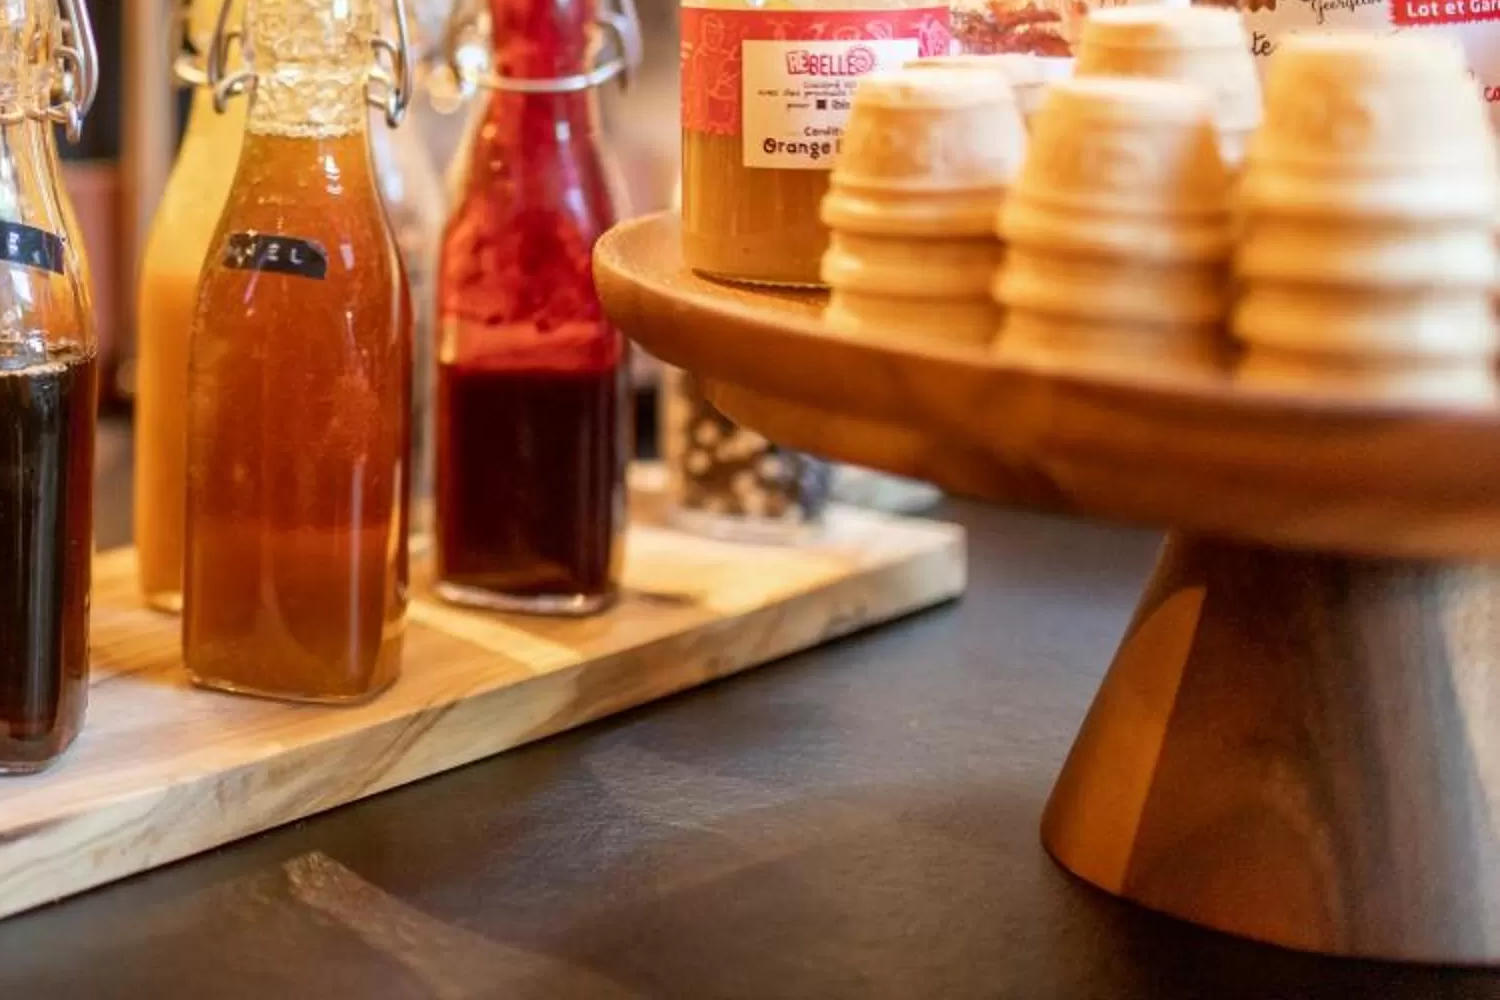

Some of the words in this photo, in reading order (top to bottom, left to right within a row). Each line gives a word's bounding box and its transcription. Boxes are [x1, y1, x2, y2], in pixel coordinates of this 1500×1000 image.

[1406, 1, 1439, 17] Lot
[1445, 1, 1466, 15] et
[763, 137, 831, 160] Orange
